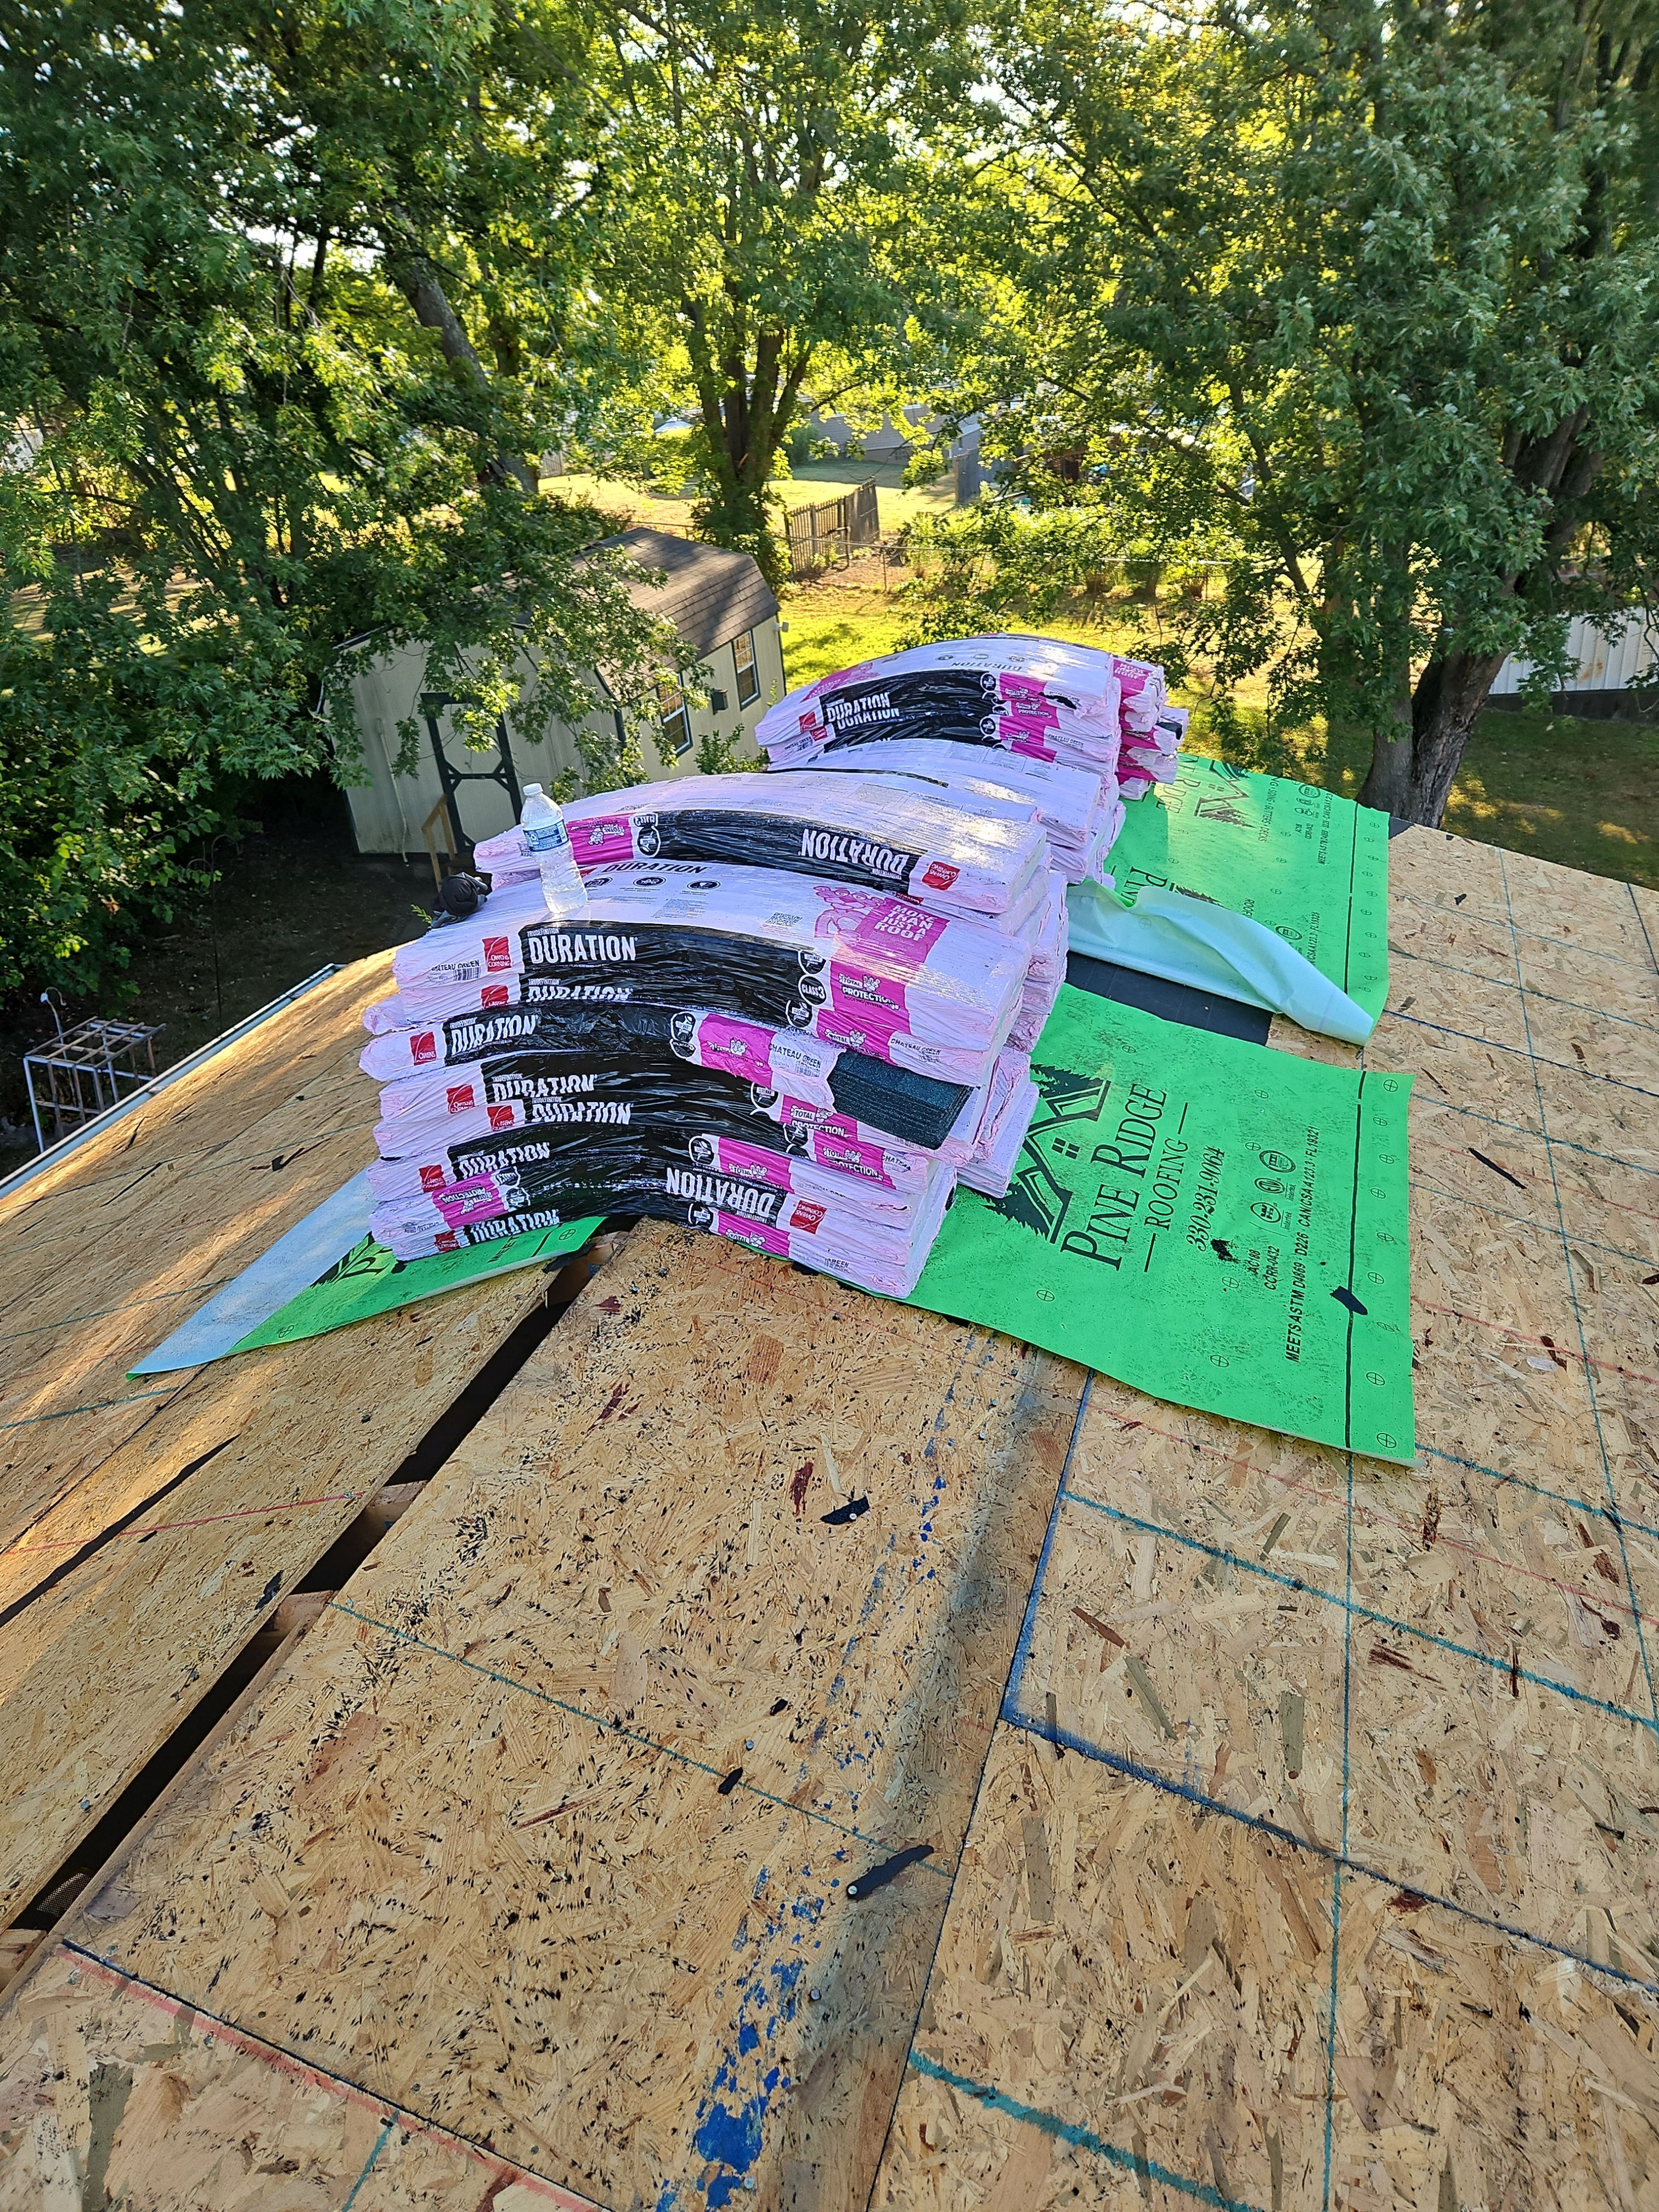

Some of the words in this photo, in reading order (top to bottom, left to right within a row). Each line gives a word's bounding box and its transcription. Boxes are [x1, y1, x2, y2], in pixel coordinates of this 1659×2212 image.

[826, 692, 891, 723] DURATION
[1018, 709, 1049, 717] PROTECTION
[801, 828, 910, 875] DURATION
[601, 862, 708, 873] DURATION
[888, 910, 933, 930] THAN
[893, 905, 938, 923] MORE
[1242, 898, 1255, 918] ROOF
[527, 928, 560, 937] TRUDEFINITION
[874, 922, 925, 941] ROOF
[881, 917, 915, 930] JUST
[529, 934, 636, 964] DURATION
[458, 960, 480, 969] GREEN
[843, 978, 861, 986] TOTAL
[451, 1015, 537, 1056] DURATION
[890, 1039, 921, 1051] CHATEAU
[768, 1043, 802, 1059] CHATEAU
[802, 1055, 822, 1069] GREEN
[493, 1074, 595, 1102] DURATION
[532, 1102, 631, 1125] DURATION
[795, 1109, 814, 1119] TOTAL
[1090, 1084, 1167, 1178] RIDGE
[1305, 1125, 1320, 1158] FL19321
[459, 1142, 550, 1180] DURATION
[827, 1149, 845, 1158] TOTAL
[443, 1187, 486, 1204] PROTECTION
[667, 1167, 776, 1218] DURATION
[1144, 1137, 1188, 1231] ROOFING
[798, 1204, 823, 1216] CORNING
[1186, 1145, 1225, 1252] 330-231-9064
[736, 1210, 768, 1223] TRUDEFINITION
[795, 1210, 816, 1221] OWENS
[1060, 1183, 1141, 1271] PINE
[1283, 1211, 1293, 1230] Intertek
[488, 1236, 519, 1263] MEET
[730, 1233, 748, 1242] TOTAL
[1294, 1231, 1309, 1256] D226
[1247, 1249, 1261, 1277] AC188
[1264, 1245, 1280, 1290] CCRR-0432
[1293, 1262, 1306, 1289] D4869
[1289, 1289, 1305, 1324] ASTM
[1286, 1323, 1302, 1363] MEETS
